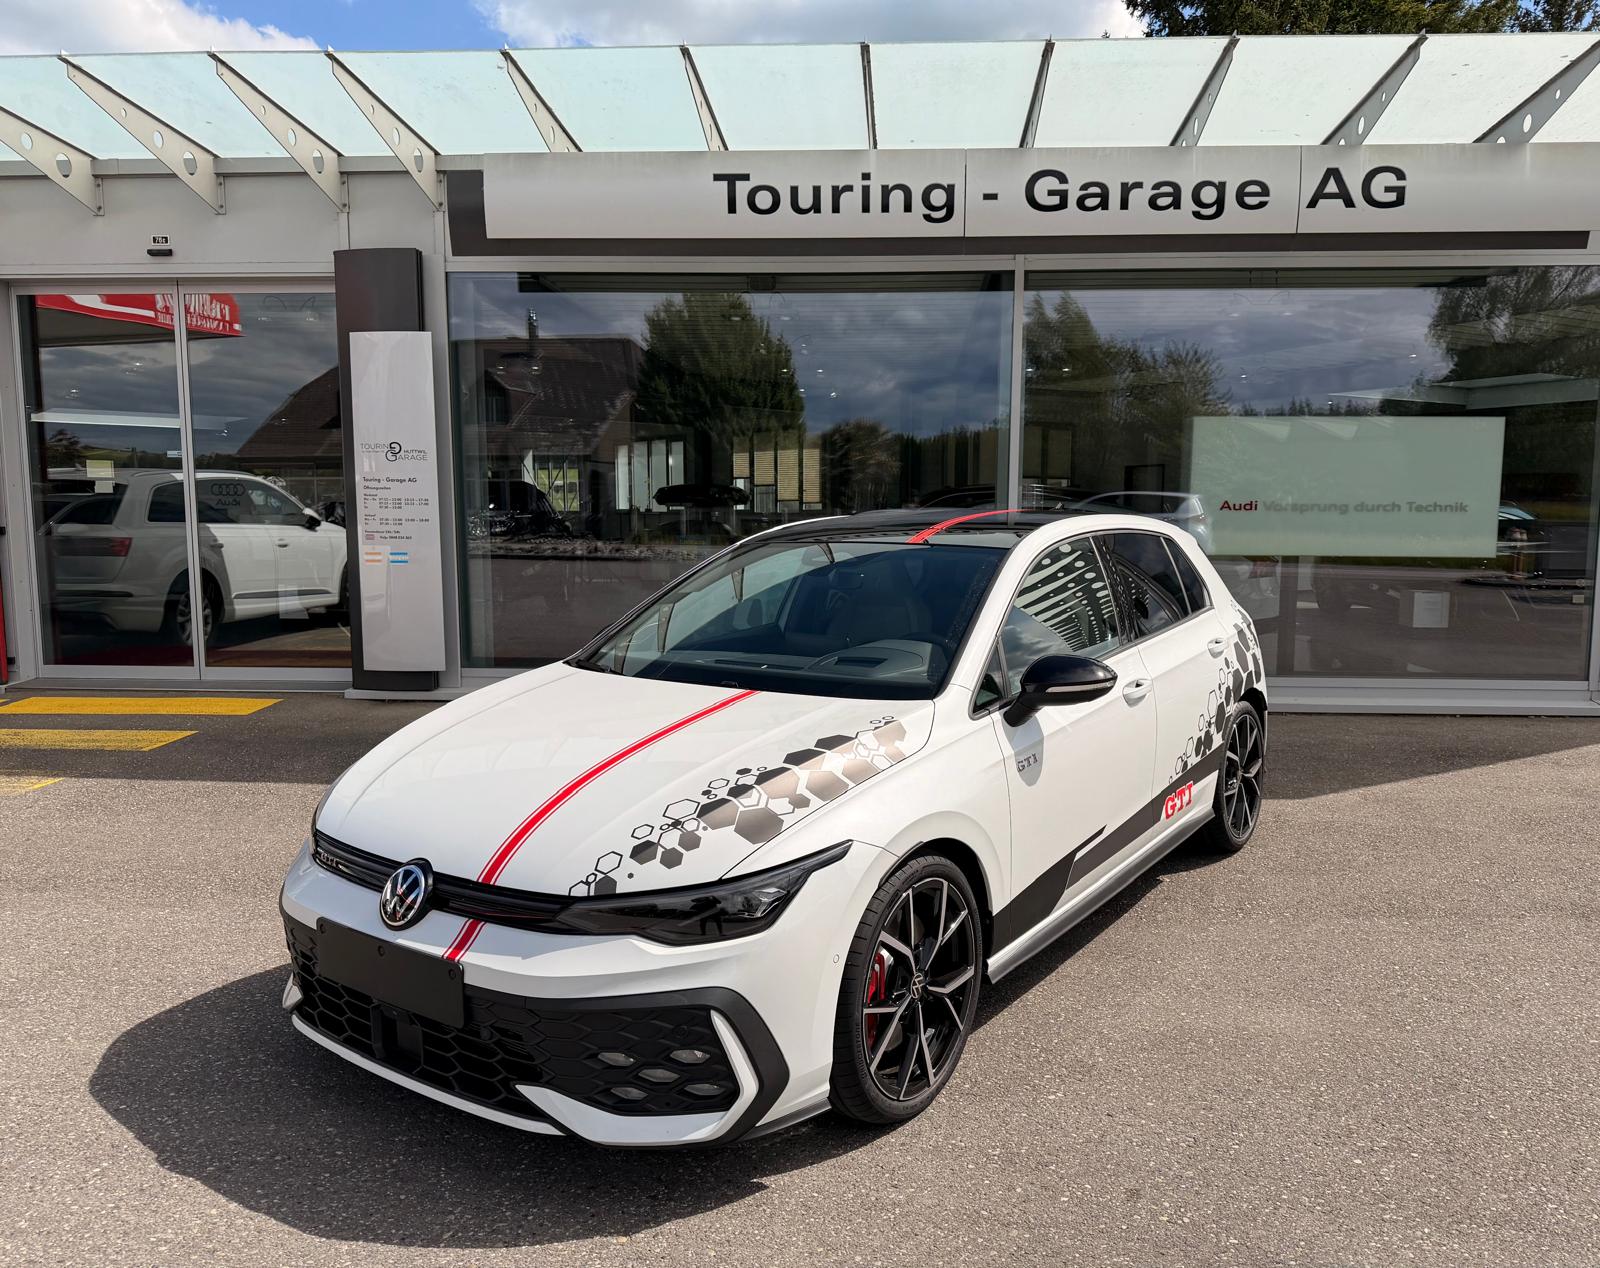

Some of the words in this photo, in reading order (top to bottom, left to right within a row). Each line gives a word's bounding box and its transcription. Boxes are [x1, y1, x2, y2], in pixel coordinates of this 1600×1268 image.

[713, 172, 956, 224] Touring
[982, 192, 999, 201] -
[1025, 169, 1271, 221] Garage
[1306, 165, 1408, 210] AG
[363, 476, 381, 484] Touring
[215, 498, 241, 506] Audi
[1219, 499, 1258, 511] Audi
[1262, 500, 1349, 515] Vorsprung
[1353, 500, 1402, 513] durch
[1406, 501, 1469, 513] Technik
[1017, 752, 1038, 772] GTI
[1164, 781, 1194, 820] GTI
